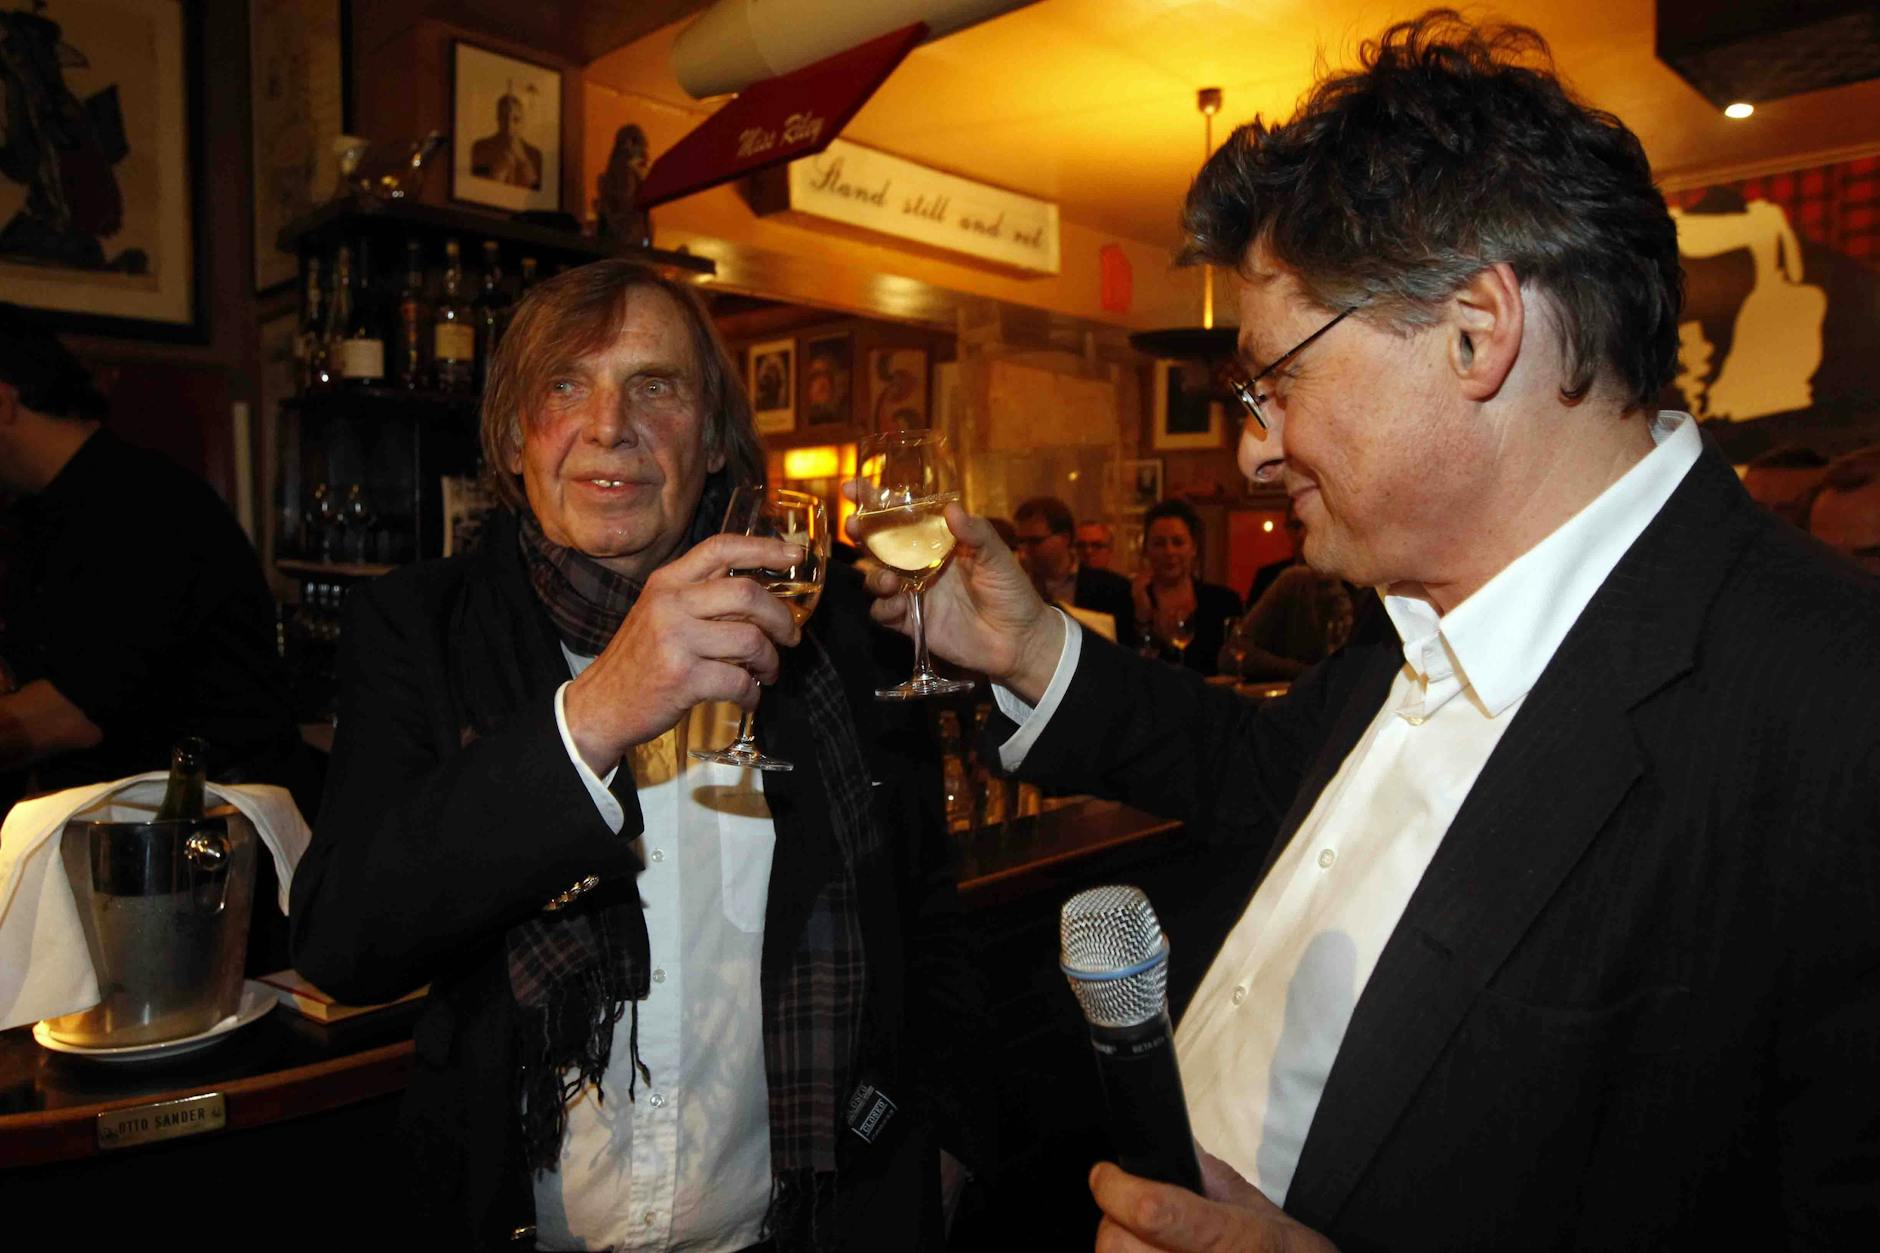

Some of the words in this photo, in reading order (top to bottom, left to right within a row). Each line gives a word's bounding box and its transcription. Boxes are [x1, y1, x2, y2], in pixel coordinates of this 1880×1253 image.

[737, 127, 776, 156] Miss
[810, 157, 890, 207] Stand
[902, 194, 950, 221] still
[958, 211, 1005, 237] and
[118, 1117, 148, 1134] OTTO
[154, 1108, 206, 1128] SANDER
[863, 1101, 885, 1132] CLOSED
